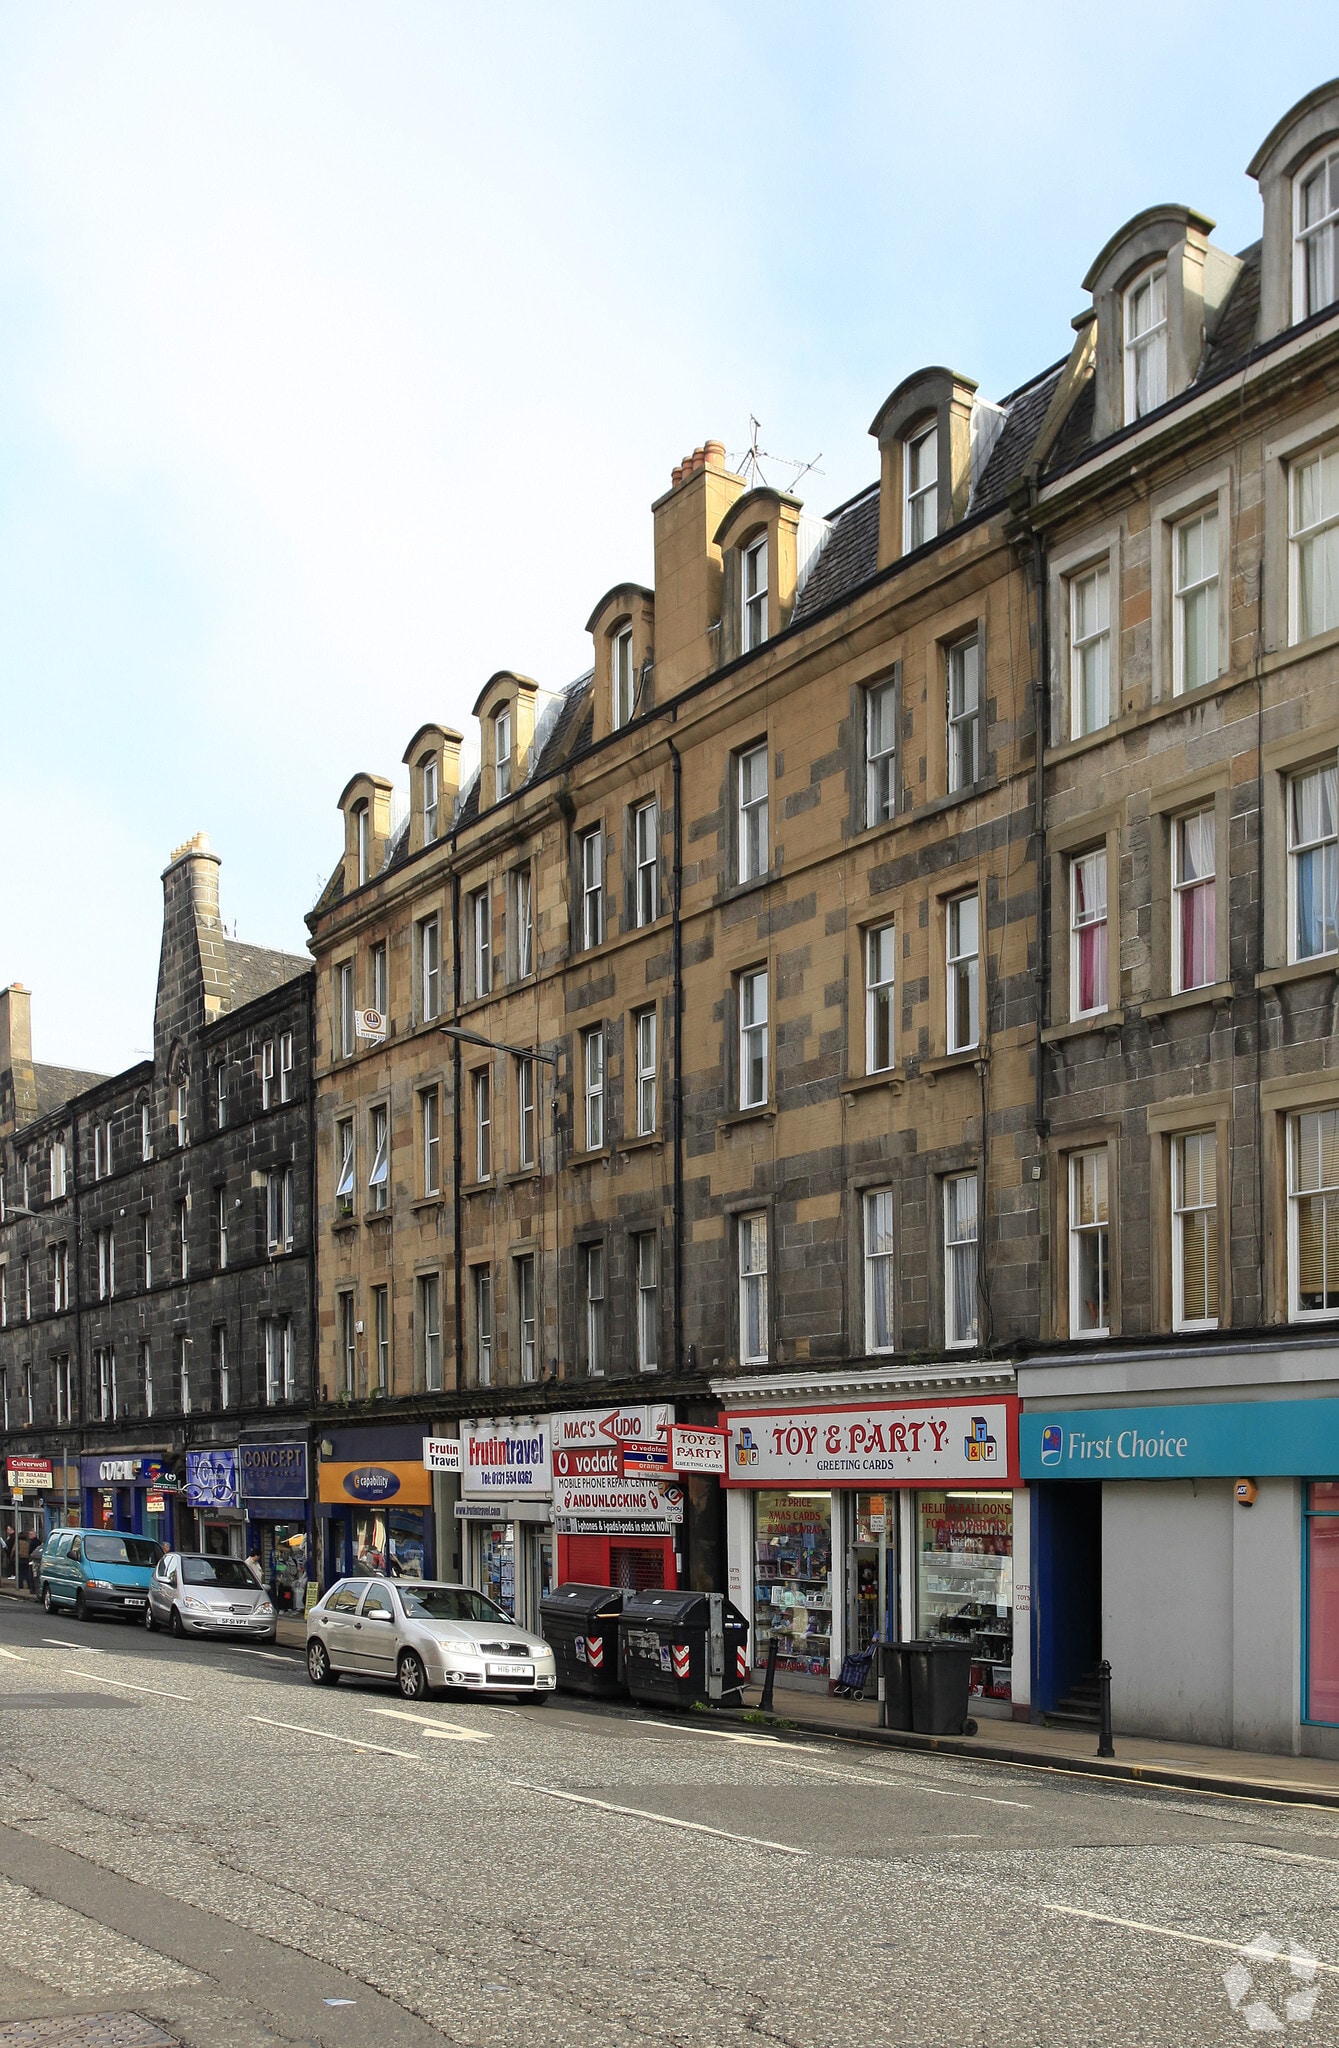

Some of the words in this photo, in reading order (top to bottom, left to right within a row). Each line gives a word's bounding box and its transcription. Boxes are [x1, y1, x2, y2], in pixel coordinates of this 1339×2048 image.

[564, 1420, 595, 1439] MAC'S
[680, 1434, 704, 1445] TOY
[708, 1436, 717, 1446] &
[772, 1426, 818, 1456] TOY
[825, 1425, 842, 1454] &
[848, 1420, 947, 1454] PARTY
[429, 1443, 459, 1455] Frutin
[1068, 1433, 1113, 1459] First
[1117, 1430, 1188, 1458] Choice
[244, 1449, 302, 1468] CONCEPT
[677, 1447, 721, 1459] PARTY
[11, 1460, 48, 1468] Culverwell
[430, 1455, 459, 1467] Travel
[639, 1463, 664, 1471] orange
[816, 1460, 861, 1471] GREETING
[862, 1460, 894, 1470] CARDS
[100, 1460, 136, 1480] CORAL
[360, 1475, 389, 1488] capability
[491, 1471, 505, 1485] 0131
[505, 1470, 517, 1485] 554
[558, 1478, 581, 1489] MOBILE
[582, 1478, 606, 1489] PHONE
[607, 1477, 629, 1488] REPAIR
[788, 1498, 812, 1507] PRICE
[921, 1503, 957, 1513] HELIUM
[959, 1503, 1012, 1514] BALLOONS
[768, 1511, 791, 1519] XMAS
[793, 1511, 821, 1520] CARDS
[641, 1522, 655, 1532] stock
